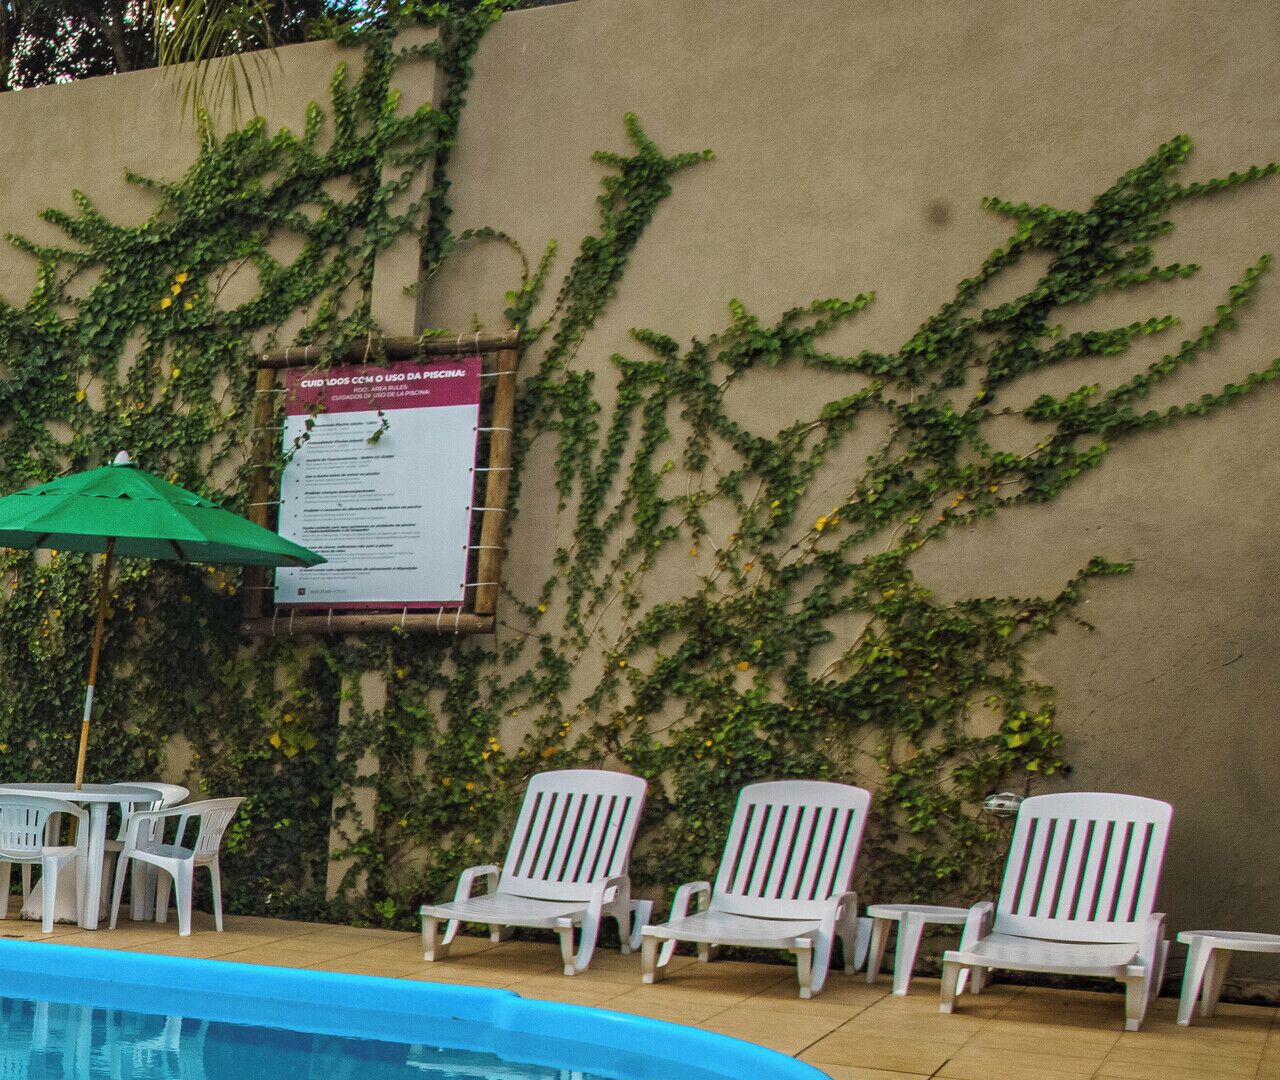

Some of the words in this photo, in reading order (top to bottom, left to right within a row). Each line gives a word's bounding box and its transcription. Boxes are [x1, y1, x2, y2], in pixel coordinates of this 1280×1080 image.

[375, 374, 384, 383] O
[385, 373, 405, 382] USO
[406, 372, 422, 381] DA
[423, 369, 466, 380] PISCINA:
